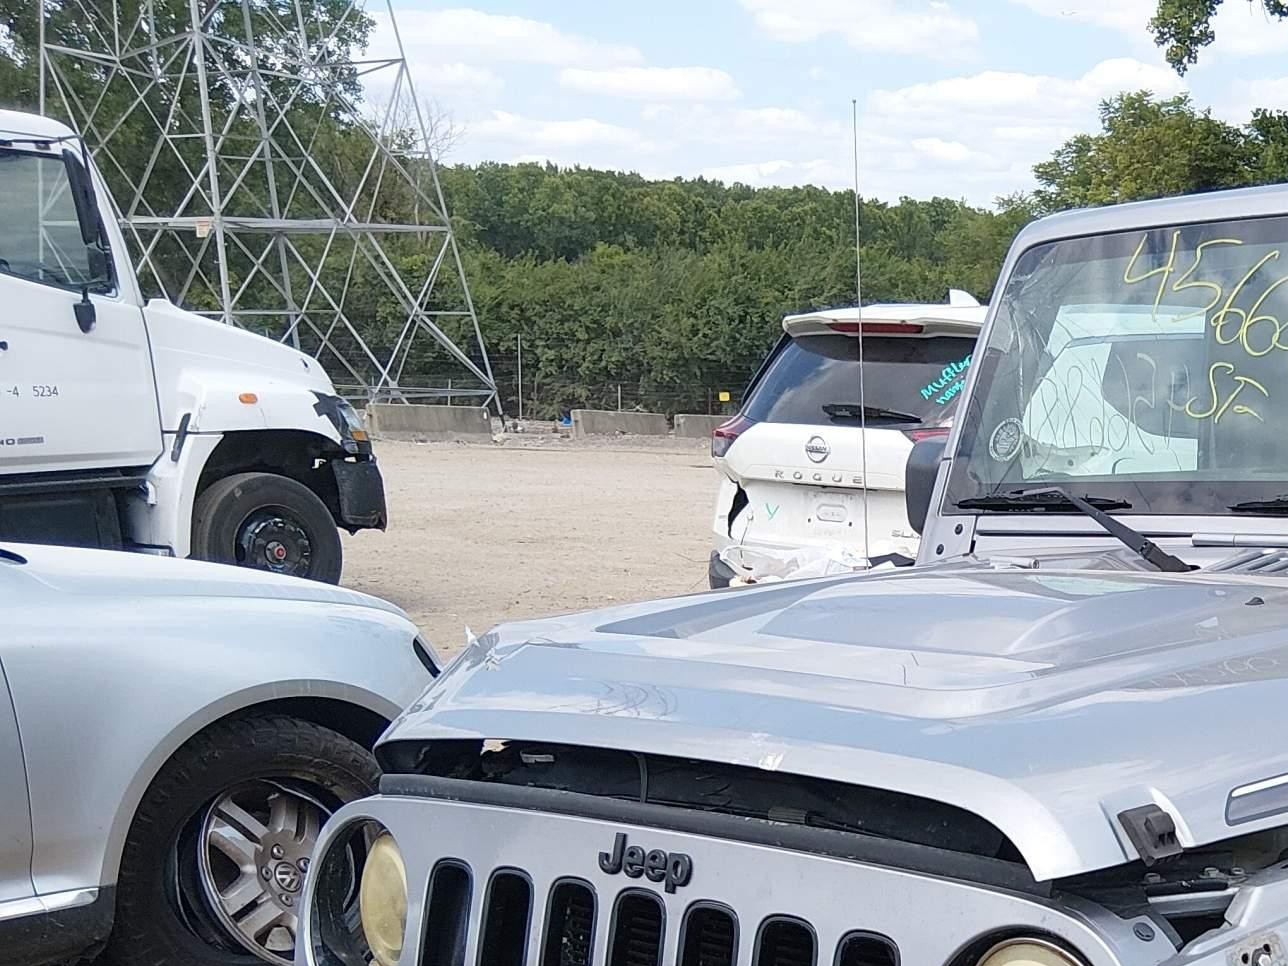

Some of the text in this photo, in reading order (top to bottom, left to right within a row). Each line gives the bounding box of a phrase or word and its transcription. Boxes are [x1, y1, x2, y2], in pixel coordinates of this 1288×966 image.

[32, 385, 59, 398] 5234
[774, 470, 864, 486] ROGUE
[598, 832, 693, 894] Jeep
